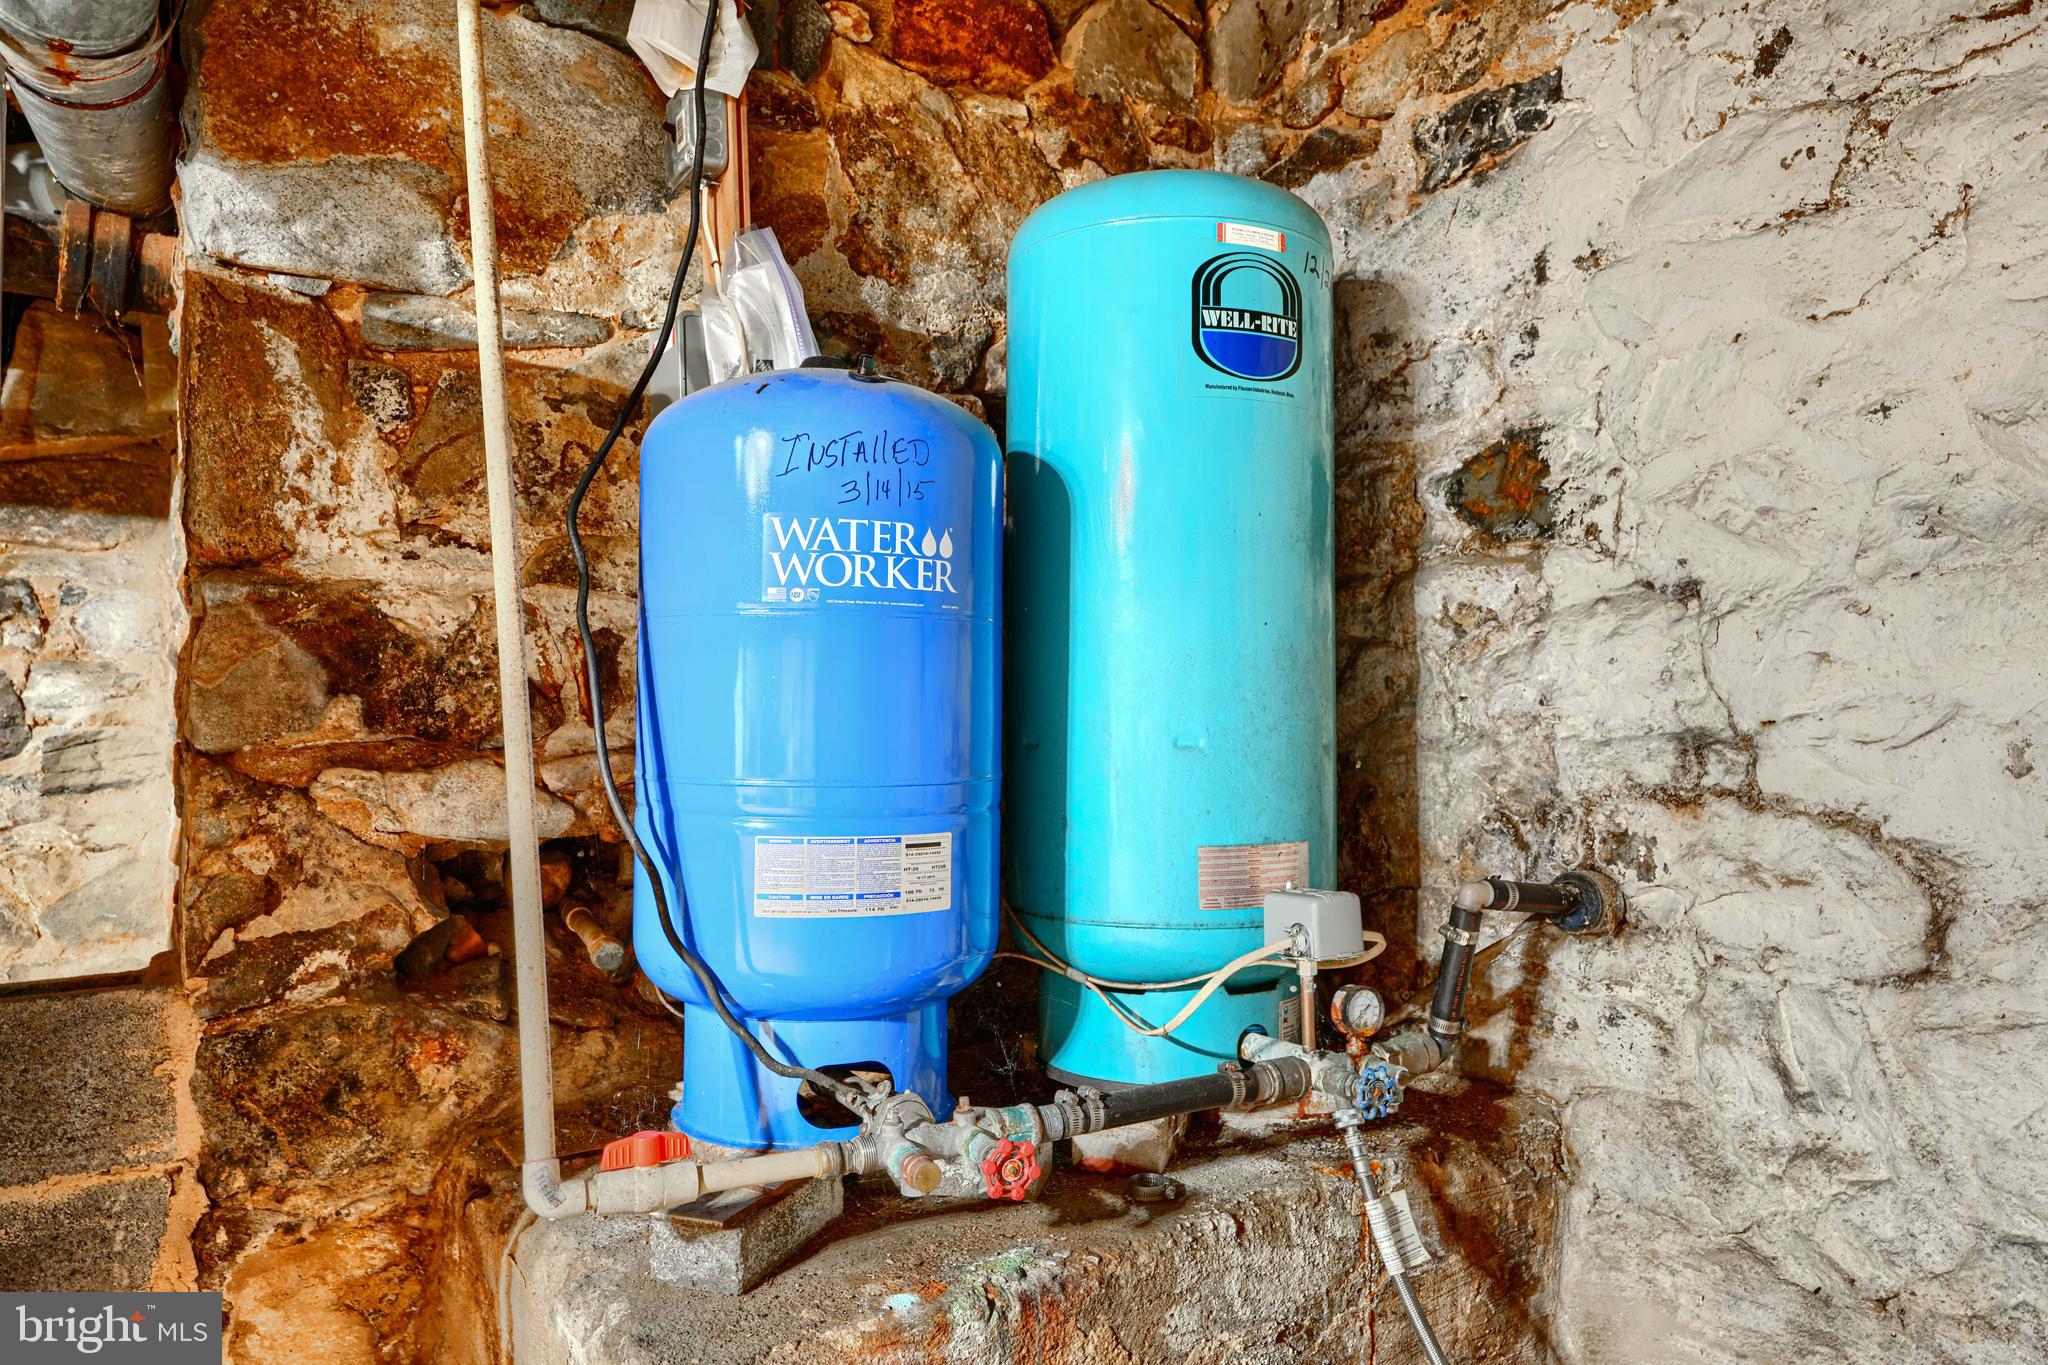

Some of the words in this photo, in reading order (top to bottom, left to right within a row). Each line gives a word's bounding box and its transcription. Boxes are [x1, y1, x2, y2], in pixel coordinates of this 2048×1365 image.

[1201, 309, 1297, 338] WELL-RITE
[838, 467, 935, 507] 3/14/15
[769, 517, 923, 556] WATER
[769, 552, 959, 594] WORKER
